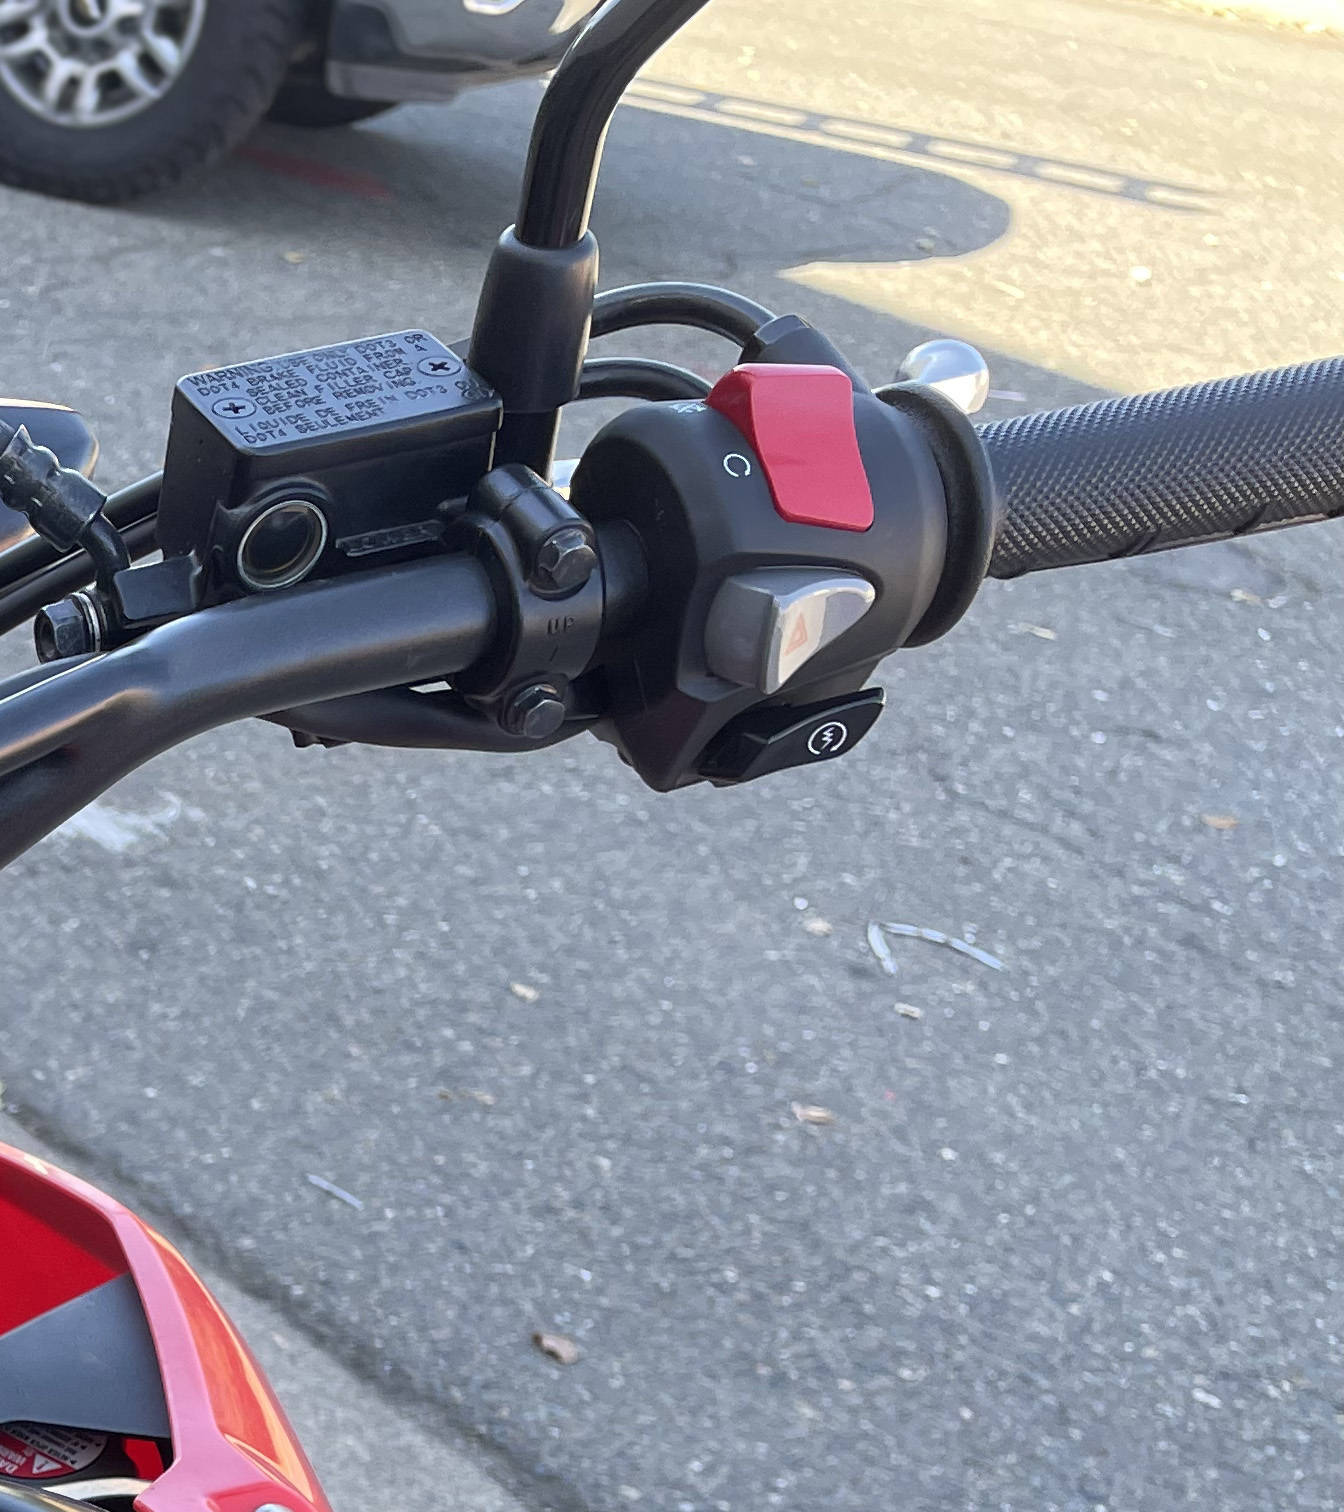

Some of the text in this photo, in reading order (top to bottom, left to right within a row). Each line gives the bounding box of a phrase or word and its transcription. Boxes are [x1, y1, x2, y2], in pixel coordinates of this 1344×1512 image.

[247, 369, 300, 386] BRAKE
[306, 357, 357, 374] FLUID
[246, 378, 308, 397] SEALED
[255, 388, 308, 406] CLEAN
[315, 407, 339, 418] DE
